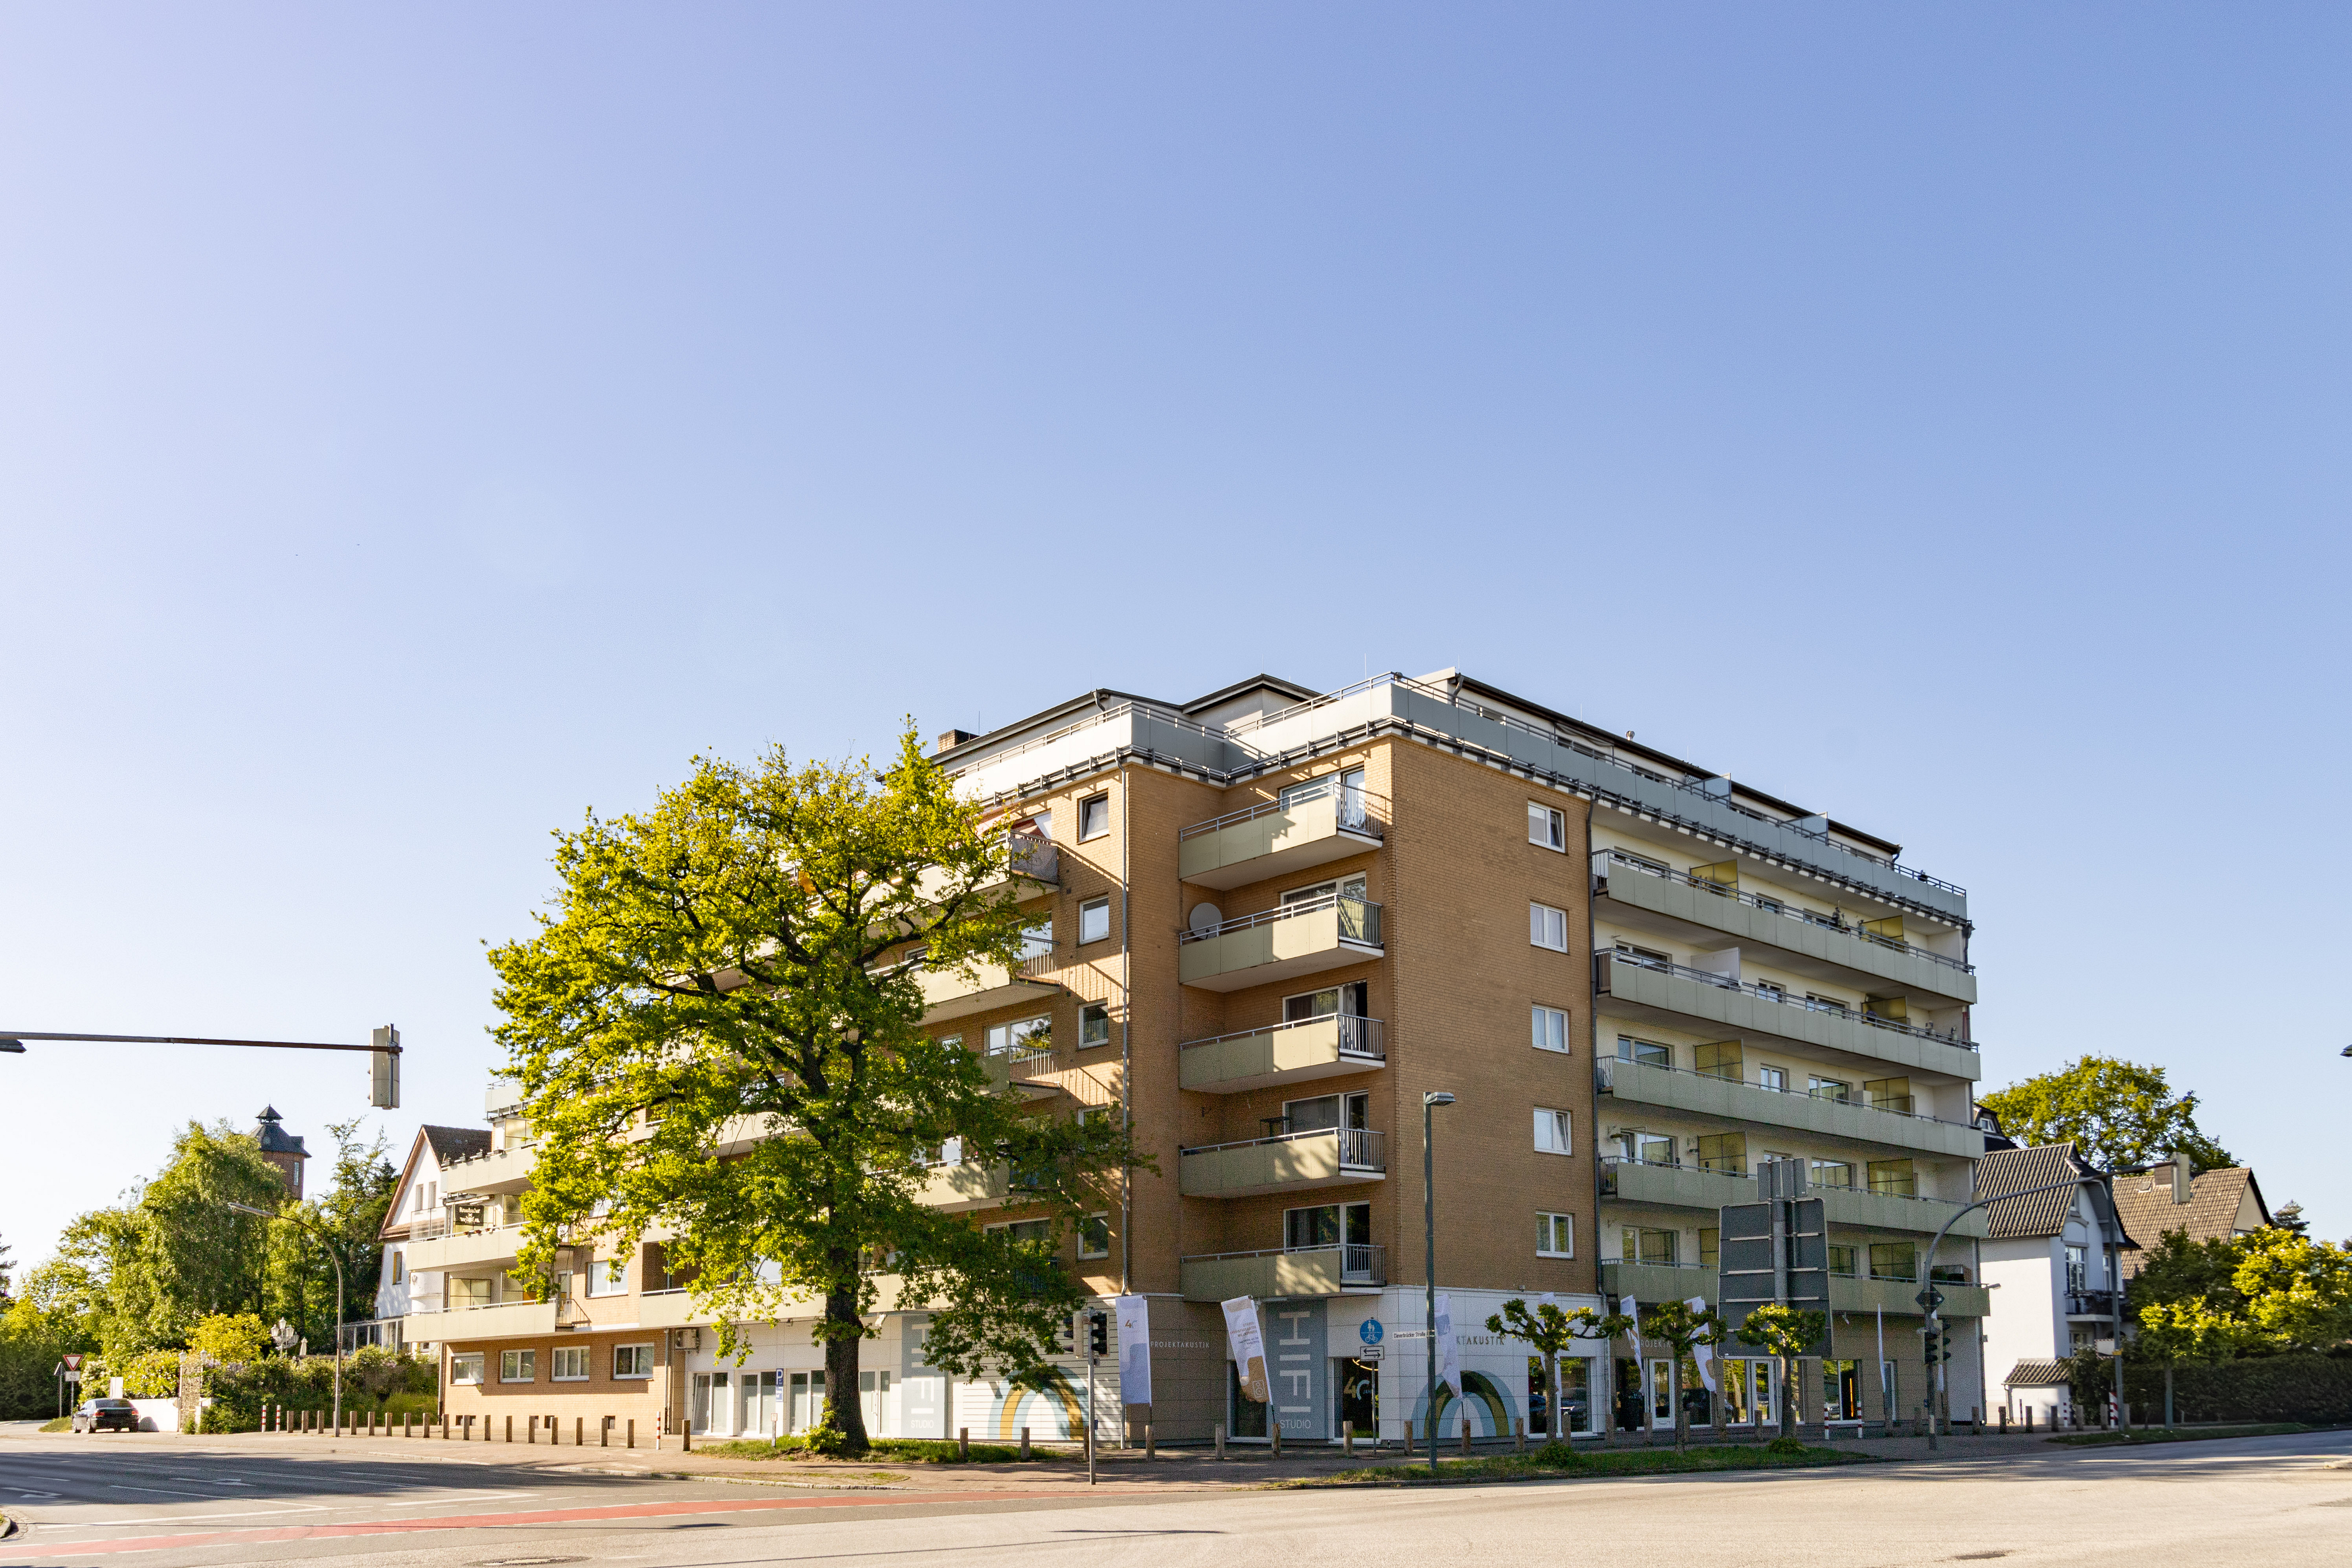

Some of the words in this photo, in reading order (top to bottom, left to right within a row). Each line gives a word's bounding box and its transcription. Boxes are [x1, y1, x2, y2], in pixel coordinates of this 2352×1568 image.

[1279, 1311, 1311, 1412] HIFI
[776, 1369, 783, 1385] P
[911, 1420, 934, 1428] STUDIO
[1280, 1420, 1311, 1428] STUDIO
